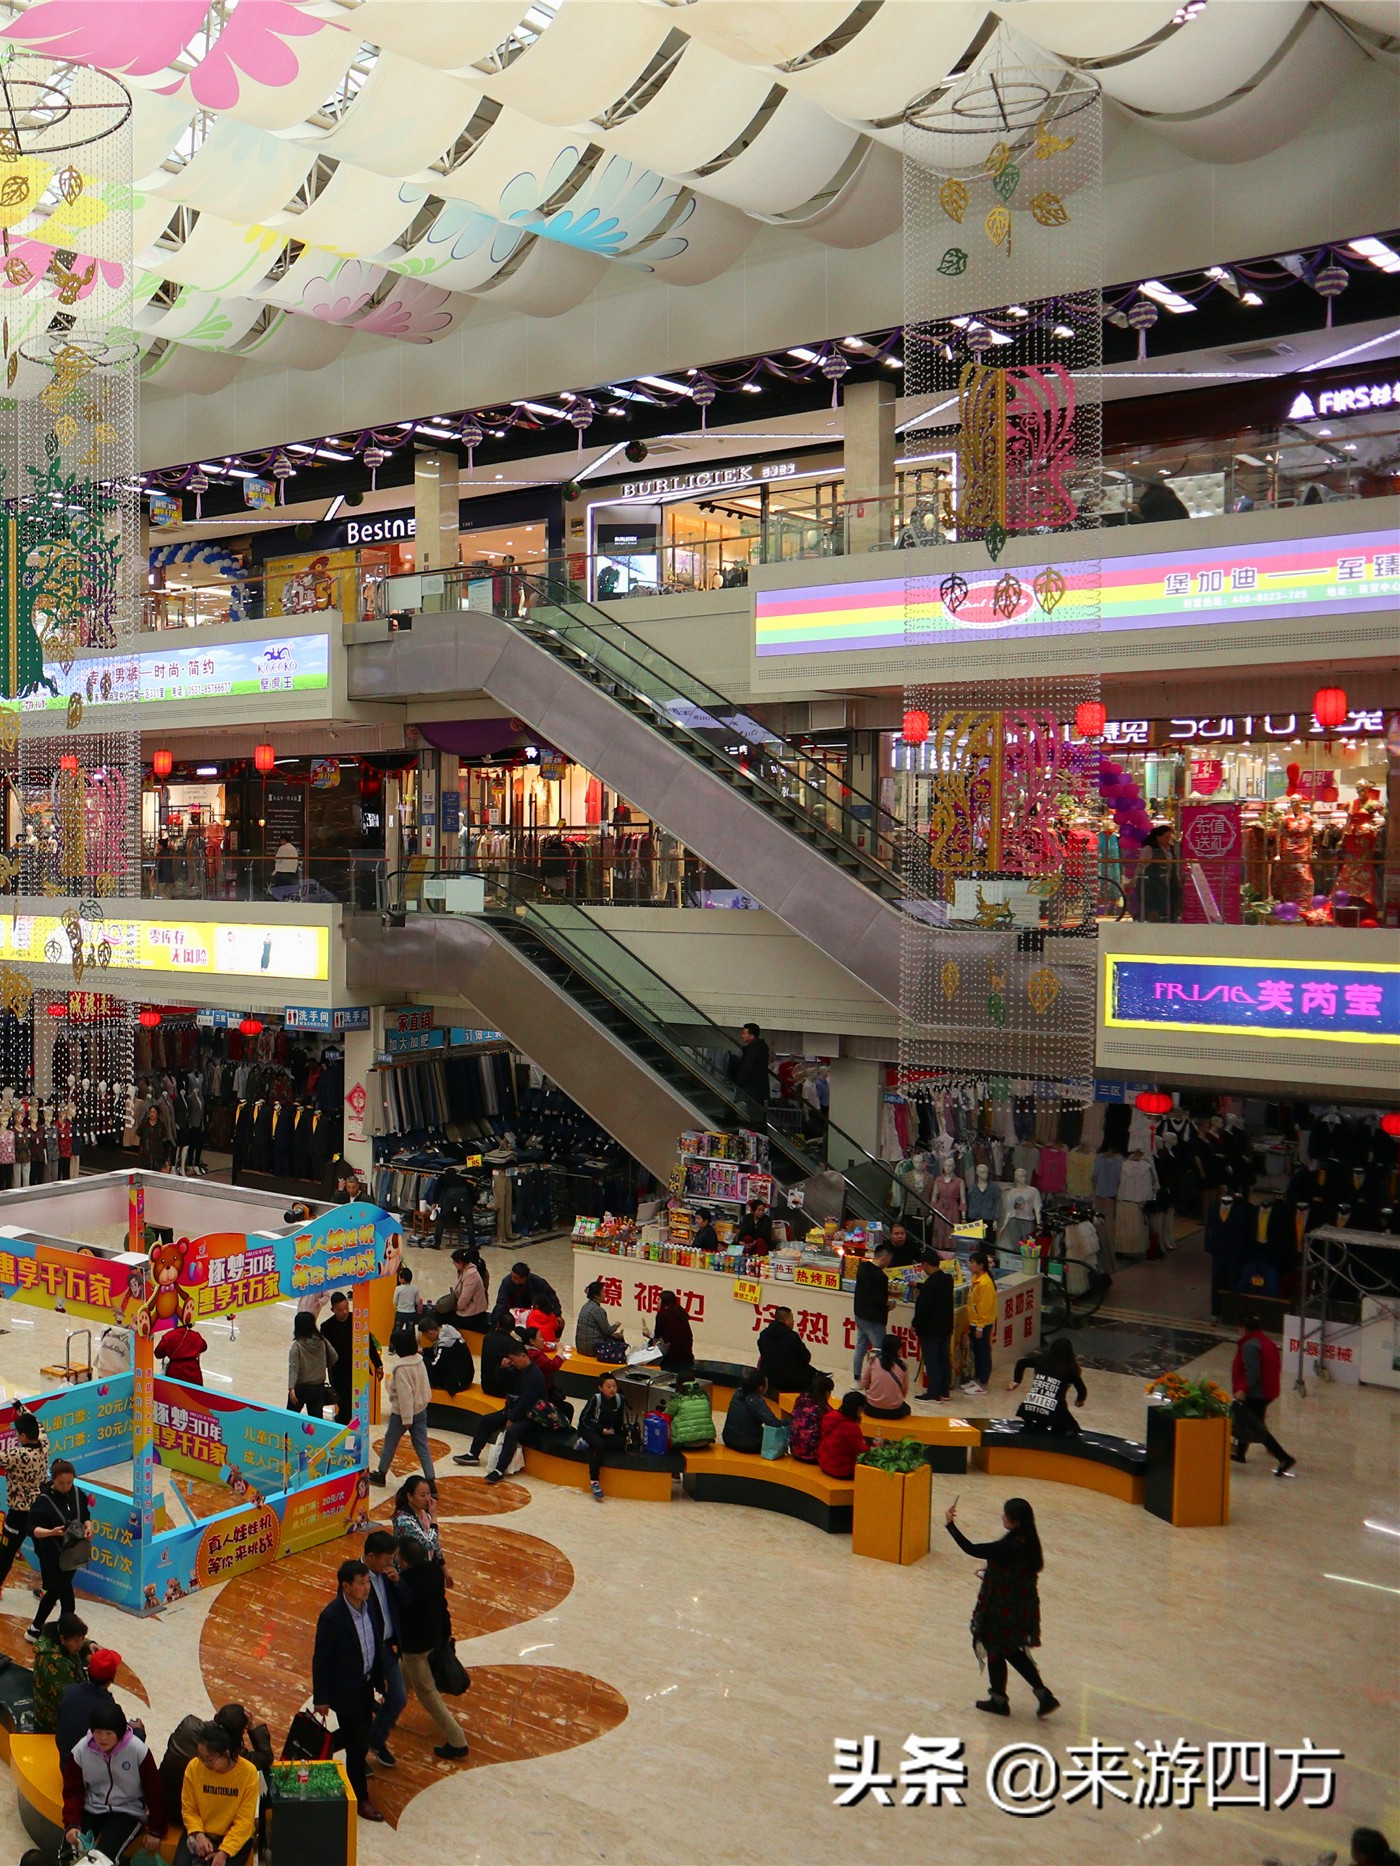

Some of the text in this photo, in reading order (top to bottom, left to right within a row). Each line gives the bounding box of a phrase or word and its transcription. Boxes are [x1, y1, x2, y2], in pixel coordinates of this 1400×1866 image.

[1165, 568, 1258, 595] 堡加迪
[1256, 980, 1385, 1016] 芙芮莹
[298, 1010, 329, 1023] 洗手间
[344, 1010, 369, 1023] 洗手间
[388, 1033, 429, 1051] 加大加肥
[1099, 1085, 1121, 1097] 三区
[207, 1254, 276, 1287] 逐梦30年
[796, 1270, 838, 1288] 热烤肠
[198, 1271, 281, 1316] 惠享千万家
[1047, 1375, 1062, 1386] NOT
[90, 1518, 134, 1548] 0元/次
[207, 1512, 272, 1555] 真人娃娃机
[90, 1546, 134, 1575] 0元/次
[207, 1533, 274, 1575] 等你来挑战
